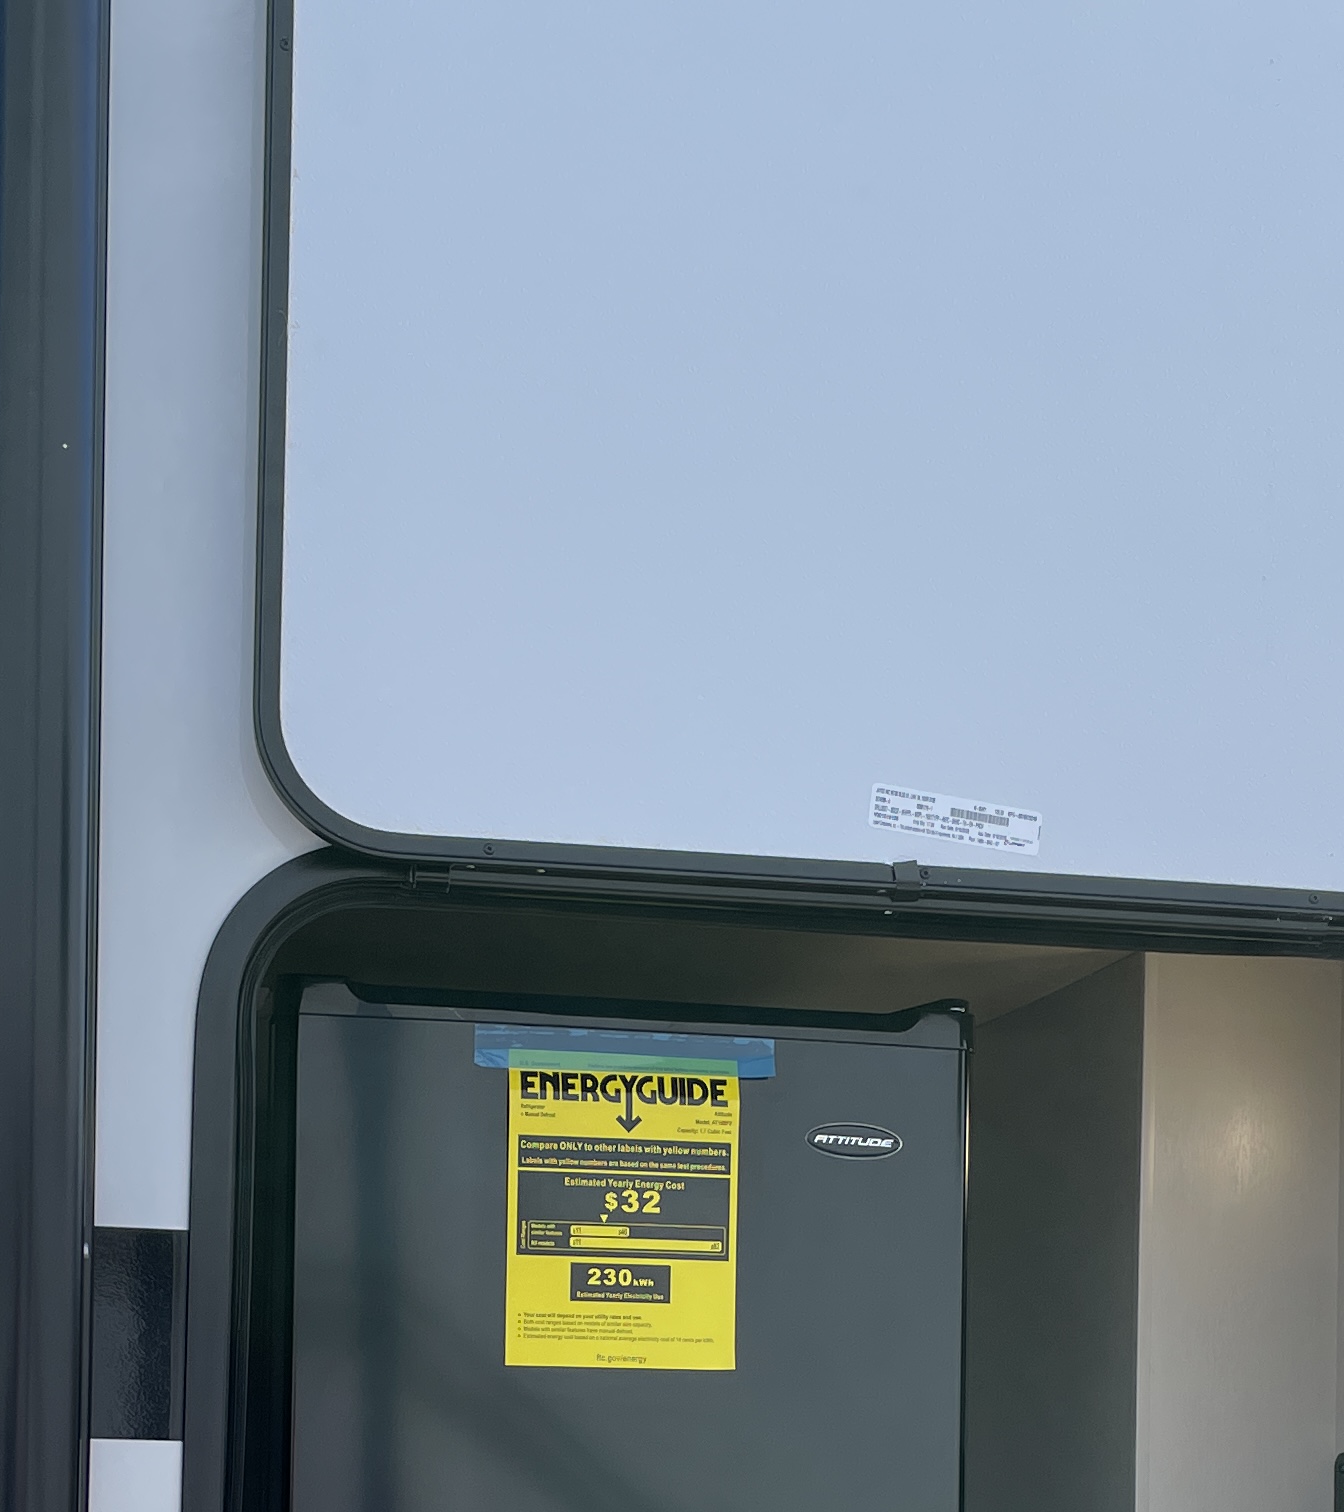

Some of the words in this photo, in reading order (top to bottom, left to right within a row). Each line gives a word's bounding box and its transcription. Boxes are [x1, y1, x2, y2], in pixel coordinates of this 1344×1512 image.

[520, 1071, 728, 1107] ENERGYGUIDE
[520, 1140, 558, 1151] Compare
[559, 1141, 582, 1151] ONLY
[584, 1142, 592, 1151] to
[594, 1143, 616, 1152] other
[617, 1143, 642, 1153] labels
[644, 1145, 662, 1154] with
[663, 1145, 689, 1156] yellow
[691, 1147, 729, 1157] numbers.
[814, 1134, 894, 1148] ATTITUDE
[564, 1176, 607, 1187] Estimated
[607, 1178, 634, 1190] Yearly
[635, 1179, 664, 1191] Energy
[665, 1180, 685, 1191] Cost
[605, 1189, 661, 1214] $32
[587, 1267, 632, 1286] 230
[633, 1278, 654, 1286] kWh
